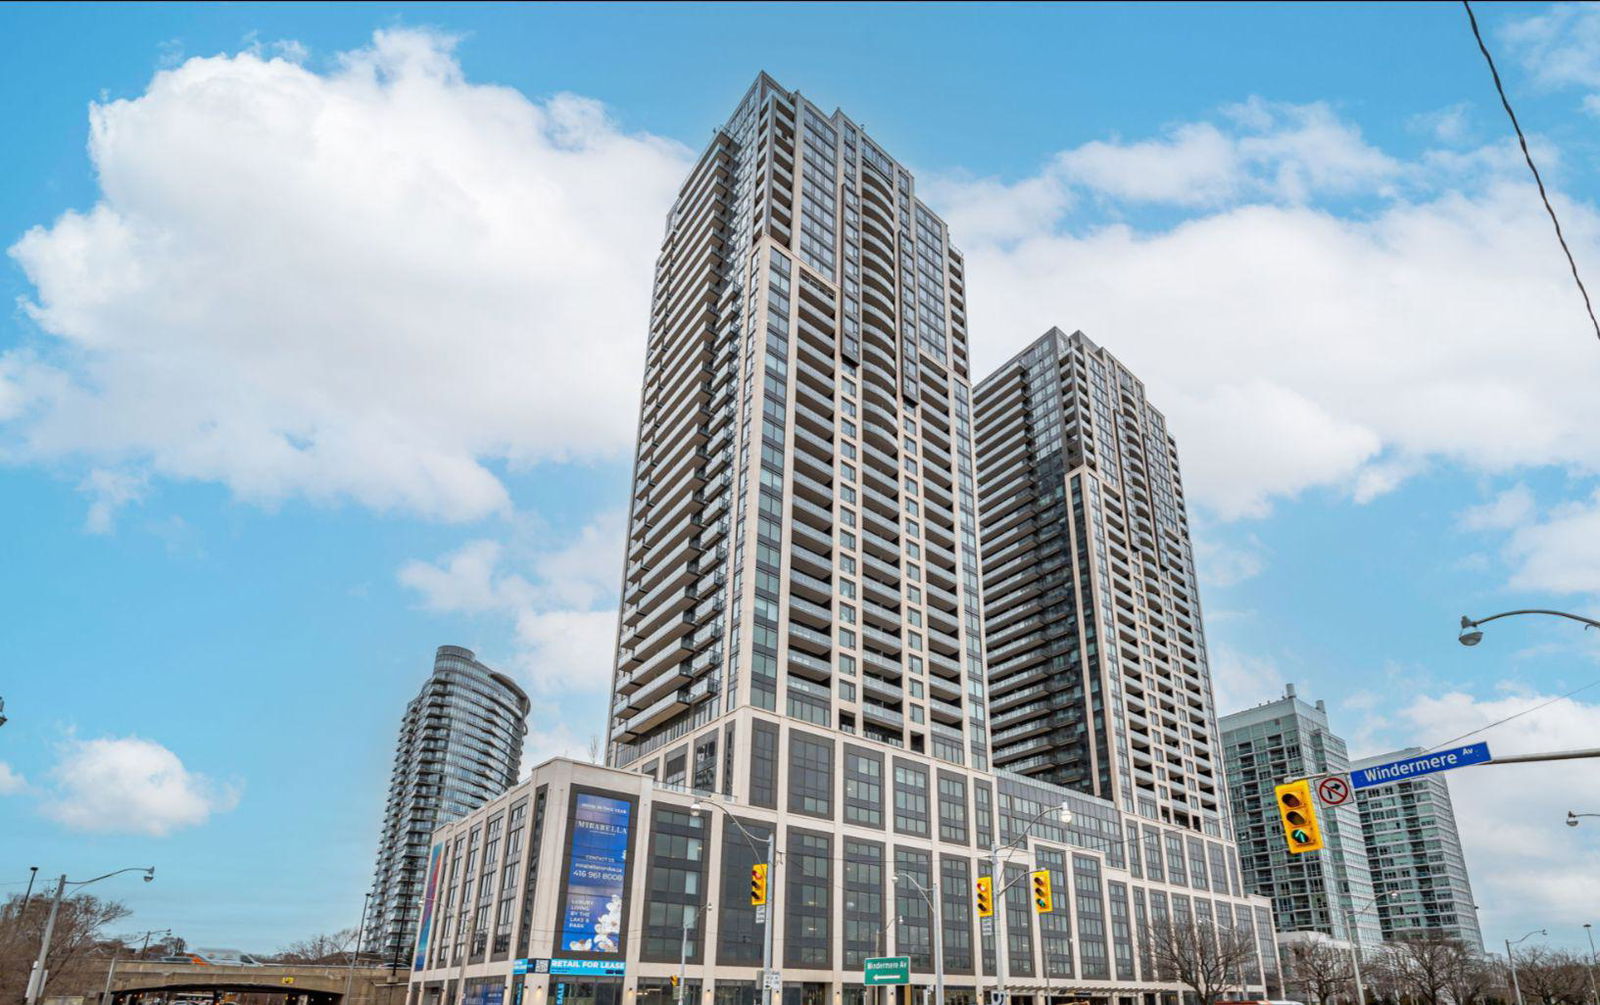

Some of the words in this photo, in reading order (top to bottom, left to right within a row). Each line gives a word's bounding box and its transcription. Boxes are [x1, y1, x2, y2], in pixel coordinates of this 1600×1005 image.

[1364, 753, 1457, 782] Windermere
[1462, 747, 1473, 756] Av
[578, 820, 628, 835] MIRABELLA
[573, 869, 587, 878] 416
[551, 959, 579, 968] RETAIL
[582, 960, 598, 968] FOR
[600, 961, 625, 969] LEASE
